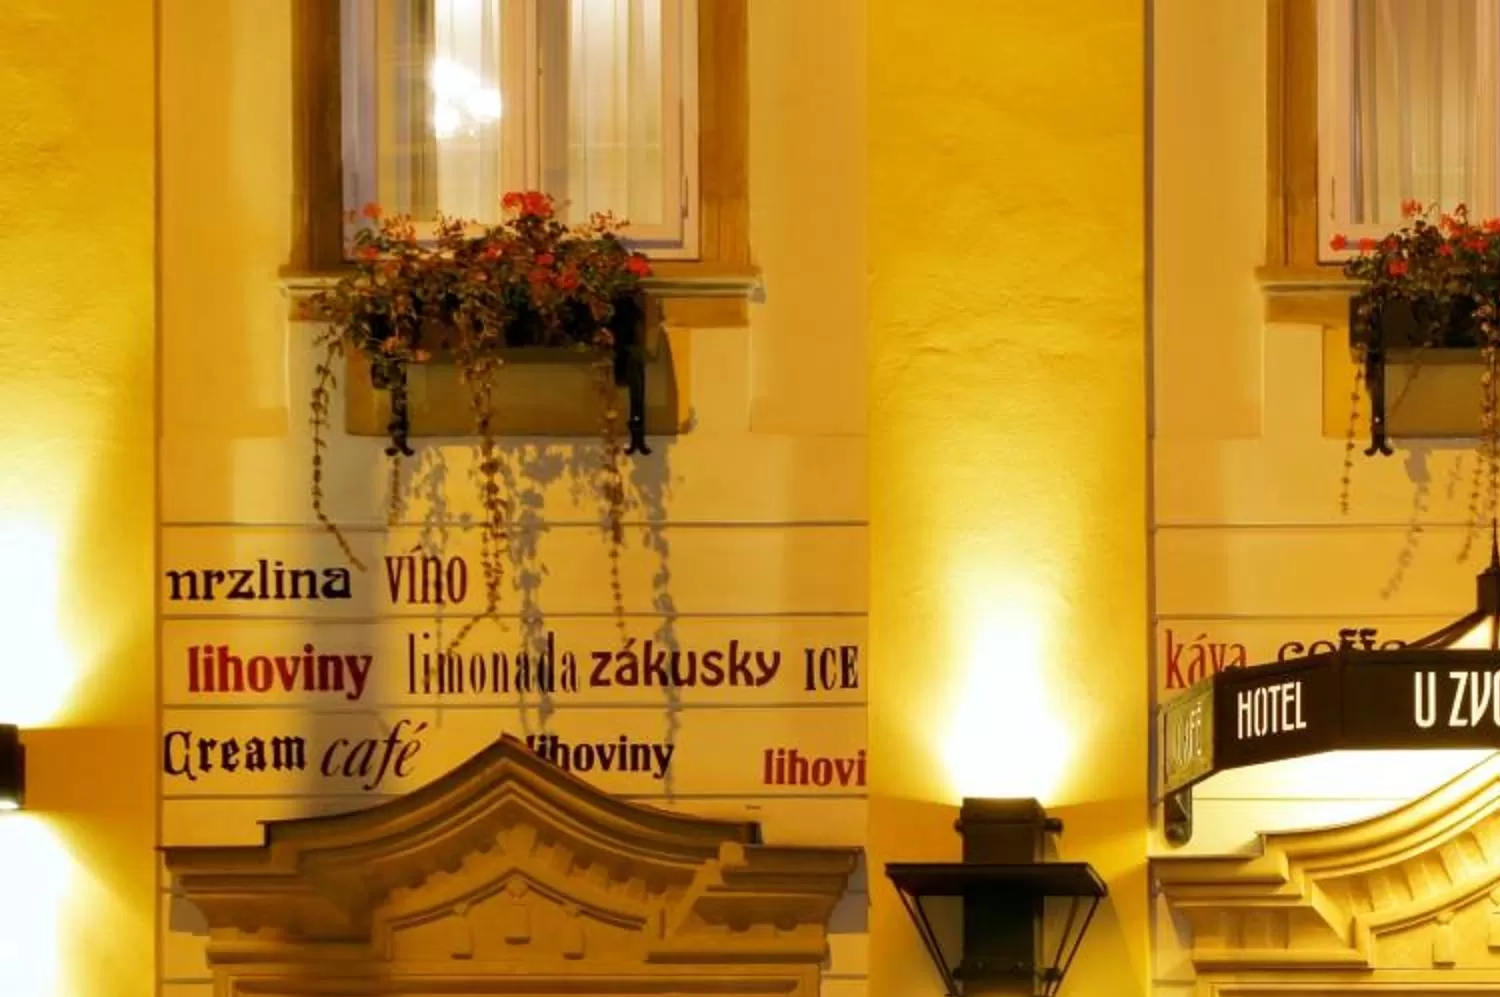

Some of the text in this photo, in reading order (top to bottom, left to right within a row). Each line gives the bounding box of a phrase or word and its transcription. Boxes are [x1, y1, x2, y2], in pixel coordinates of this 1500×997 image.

[165, 543, 468, 605] nrzlina víno
[187, 631, 859, 700] lihoviny limonada zákusky ICE
[1237, 681, 1307, 740] HOTEL
[1414, 671, 1436, 728] U
[163, 718, 428, 791] Cream café
[763, 748, 867, 787] lihovi
